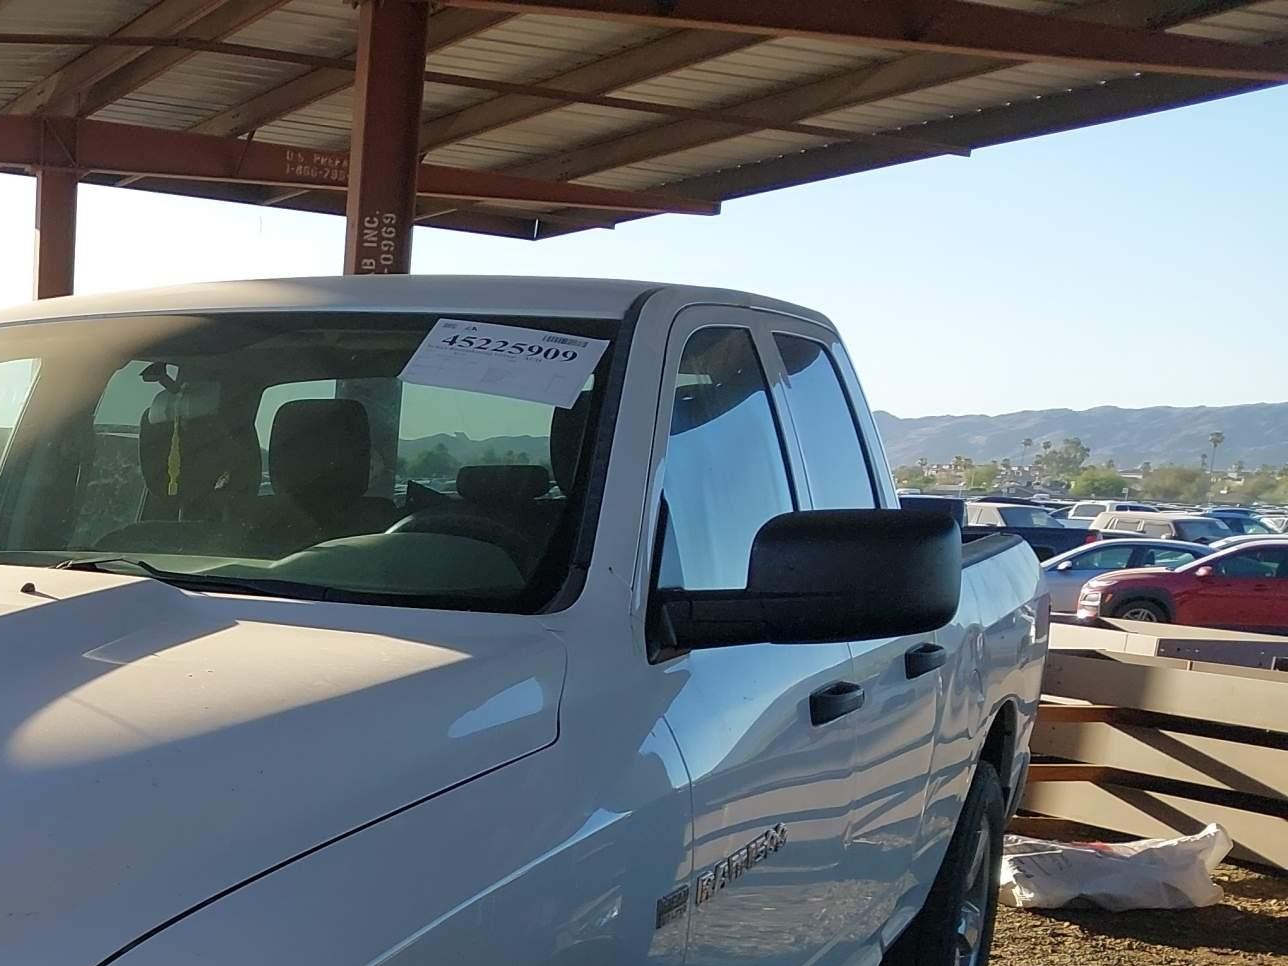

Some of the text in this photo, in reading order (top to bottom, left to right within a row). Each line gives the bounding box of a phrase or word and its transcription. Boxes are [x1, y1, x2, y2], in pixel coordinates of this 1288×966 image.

[362, 210, 379, 247] INC.
[442, 334, 578, 362] 45225909
[696, 848, 747, 907] RAM
